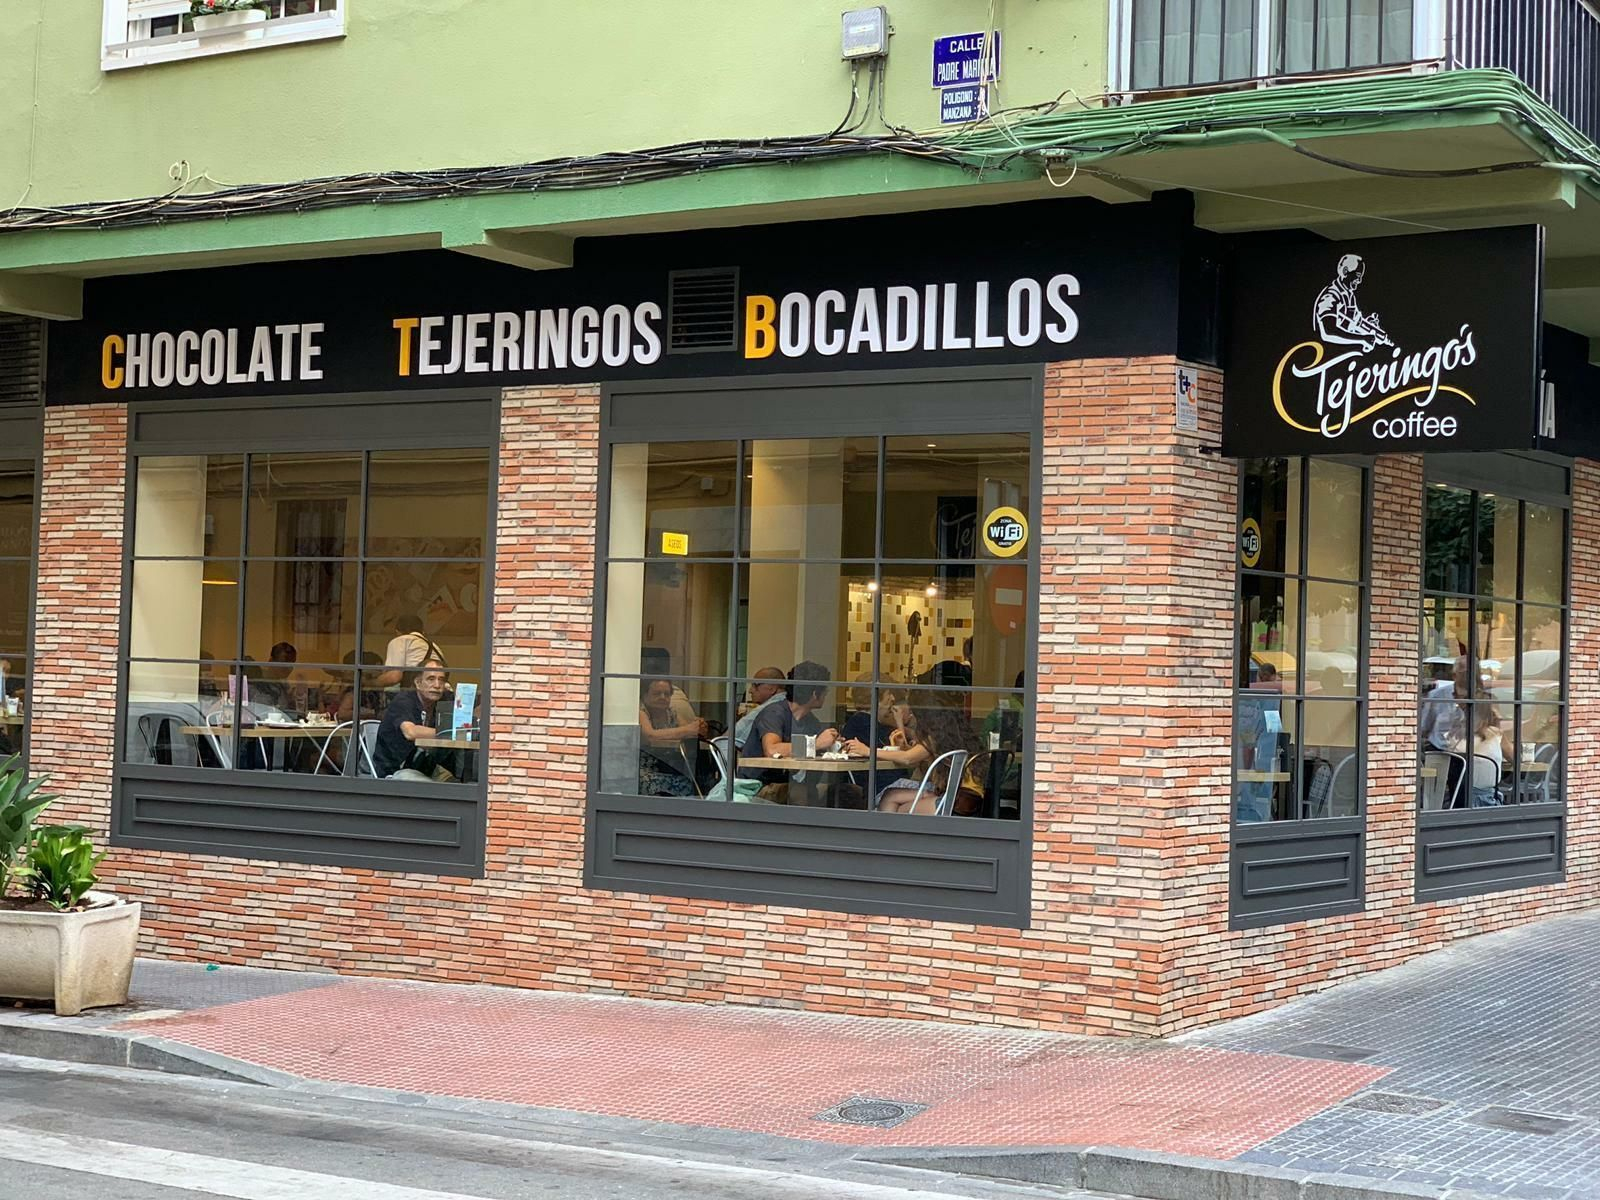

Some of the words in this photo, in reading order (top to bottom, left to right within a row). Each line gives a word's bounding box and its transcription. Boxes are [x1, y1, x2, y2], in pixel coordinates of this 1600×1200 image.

[950, 37, 985, 53] CALLE
[938, 62, 960, 83] PADRE
[101, 322, 325, 390] CHOCOLATE
[393, 301, 662, 377] TEJERINGOS
[744, 273, 1081, 360] BOCADILLOS
[1371, 410, 1458, 440] coffee
[990, 525, 1021, 538] WiFi
